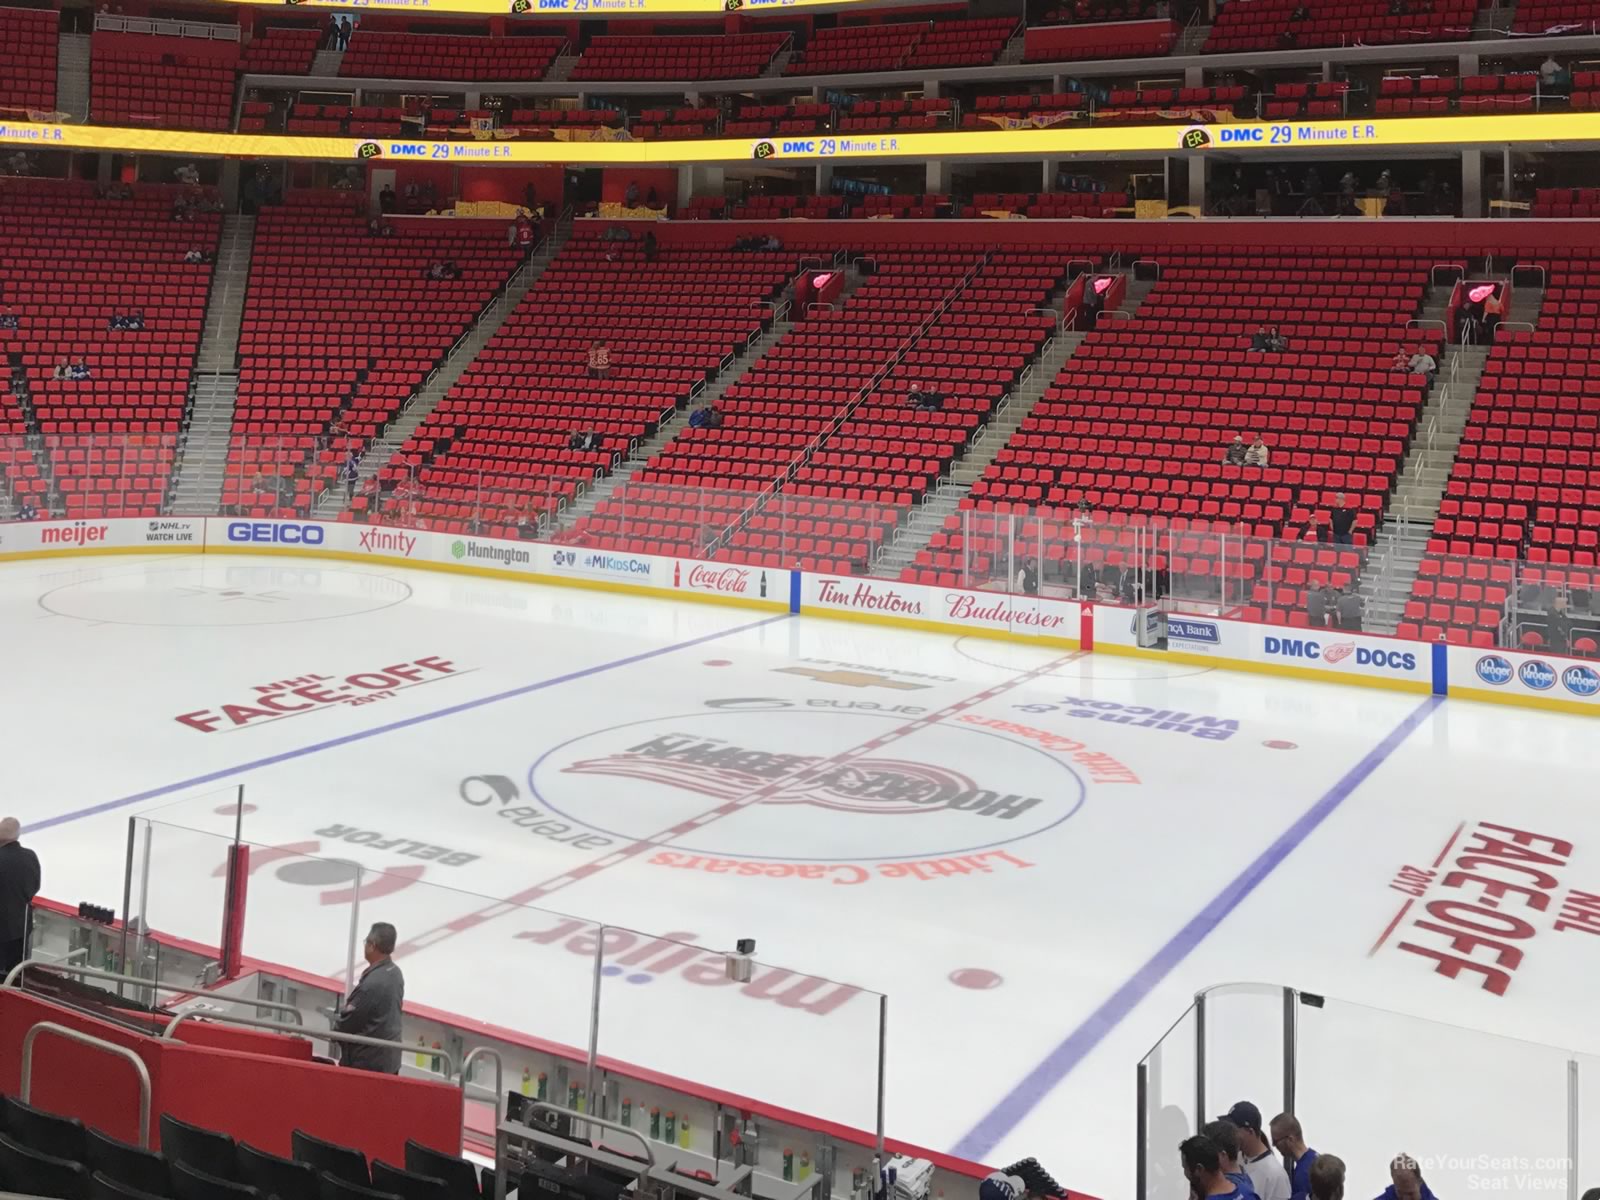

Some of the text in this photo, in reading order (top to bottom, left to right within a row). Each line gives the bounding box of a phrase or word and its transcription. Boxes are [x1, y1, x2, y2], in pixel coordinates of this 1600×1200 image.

[539, 0, 568, 8] DMC
[573, 0, 589, 11] 29
[783, 138, 900, 155] DMC 29 Minute E.R.
[1186, 130, 1204, 147] ER
[1220, 125, 1378, 144] DMC 29 Minute E.R.
[361, 143, 377, 158] ER
[391, 144, 512, 159] DMC 29 Minute E.R.
[757, 143, 770, 158] ER
[41, 521, 108, 546] meijer
[146, 533, 193, 542] WATCH LIVE
[228, 522, 324, 545] GEICO
[359, 528, 416, 557] xfinity
[468, 541, 529, 565] Huntington
[689, 564, 750, 593] Coca-Cola
[818, 579, 922, 615] Tim Hortons
[945, 593, 1065, 629] Budweiser
[1186, 624, 1212, 637] Bank
[1264, 637, 1320, 659] DMC
[1356, 647, 1416, 671] DOCS
[1481, 659, 1512, 682] Kroger
[1523, 663, 1554, 687] Kroger
[1567, 668, 1600, 693] Kroger
[174, 656, 456, 733] FACE-OFF
[250, 673, 336, 694] NHL
[341, 690, 398, 707] 2017
[805, 698, 928, 715] arena
[1060, 696, 1240, 731] Wilcox
[1065, 709, 1236, 741] Burns
[954, 714, 1087, 751] Caesars
[496, 804, 615, 851] arena
[314, 823, 483, 867] BELFOR
[648, 849, 1036, 885] Little Caesars
[1388, 864, 1437, 898] 2017
[1397, 821, 1574, 997] FACE-OFF
[512, 918, 864, 1016] meijer
